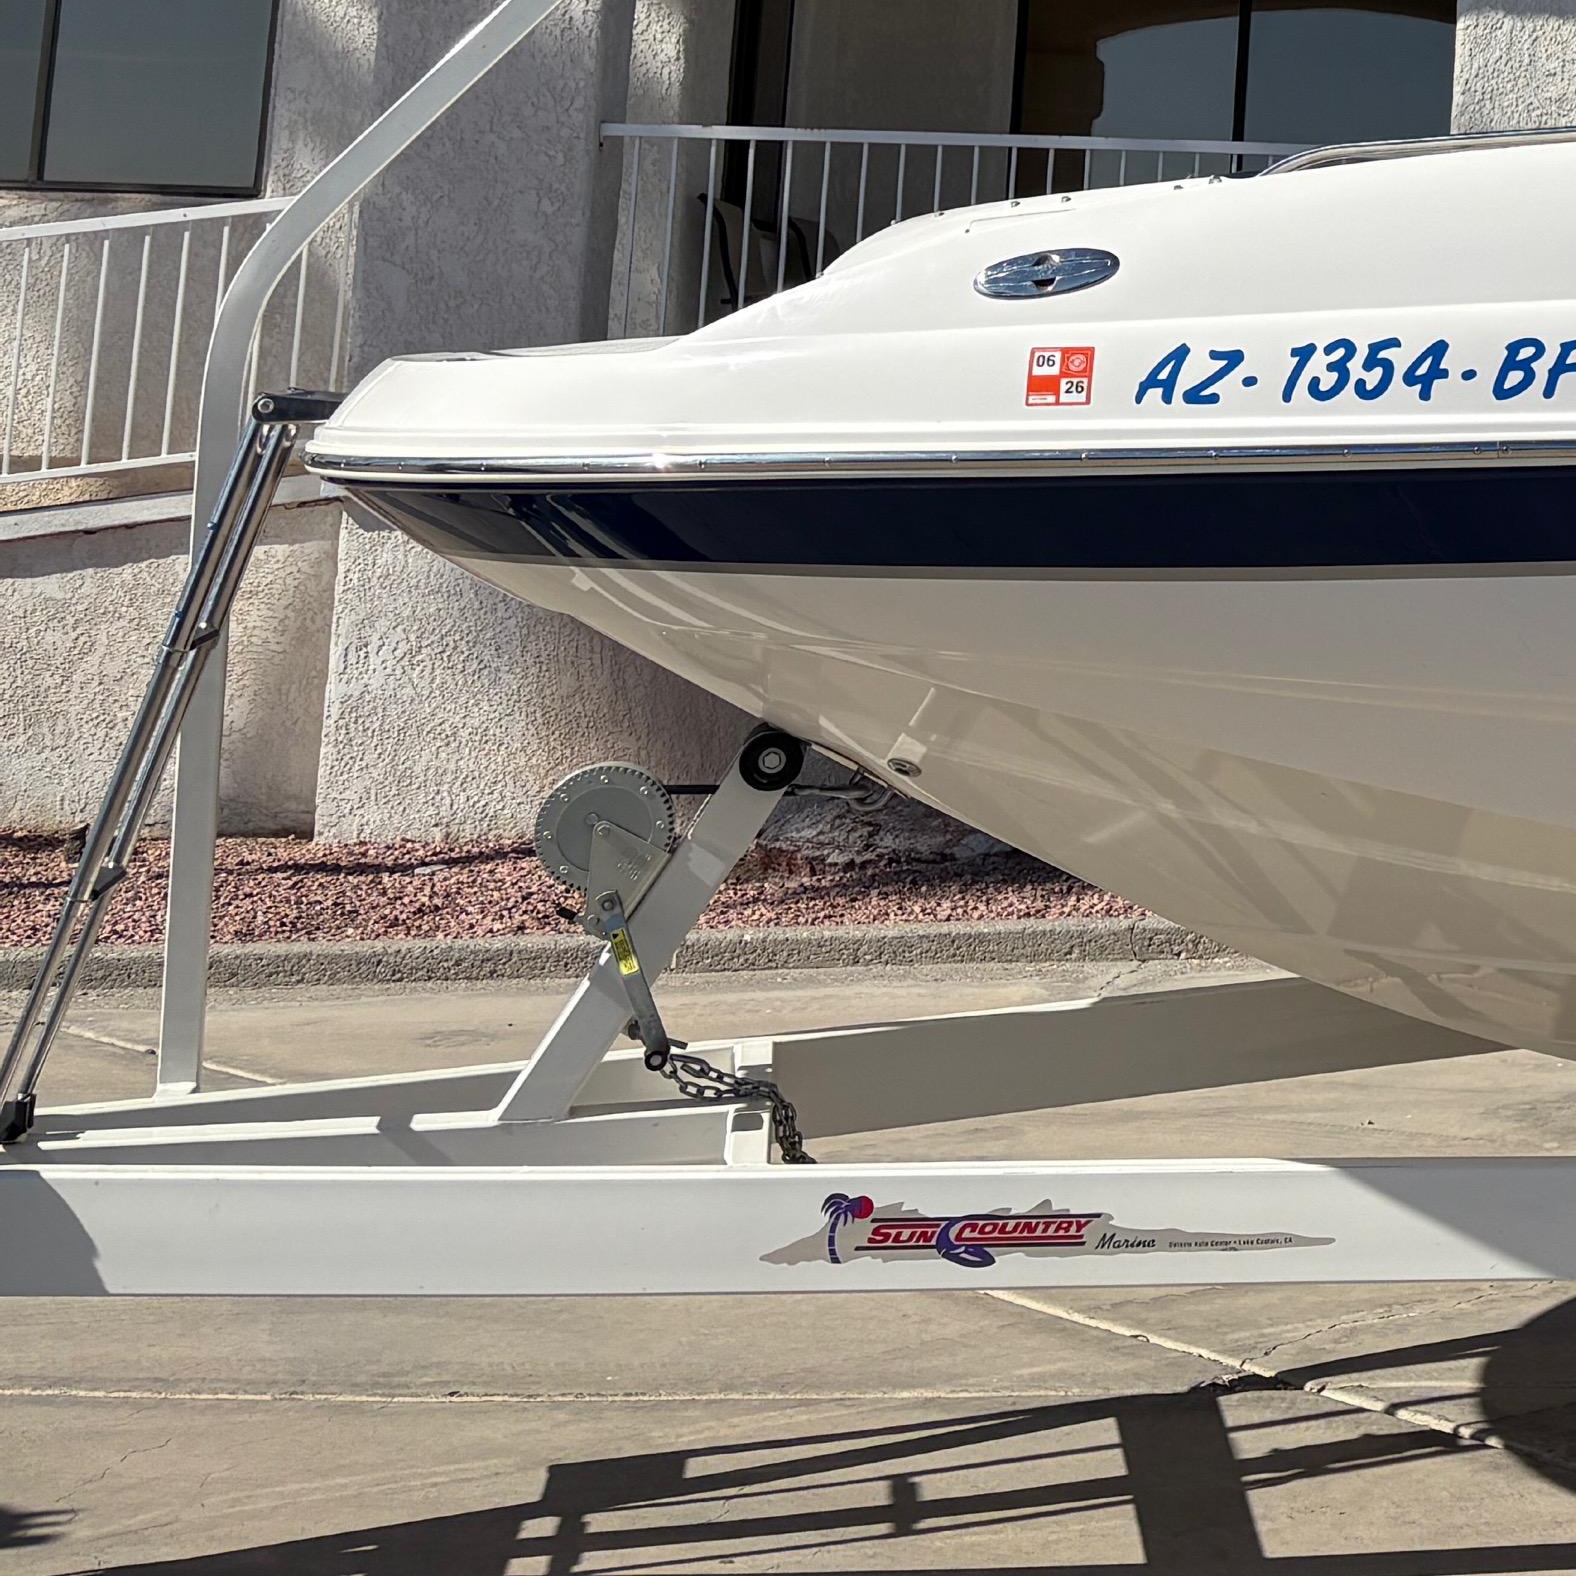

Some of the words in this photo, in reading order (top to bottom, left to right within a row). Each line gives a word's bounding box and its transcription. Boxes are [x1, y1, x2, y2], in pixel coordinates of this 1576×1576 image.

[1036, 354, 1056, 368] 06
[1064, 380, 1085, 394] 26
[867, 1222, 938, 1245] SUN
[953, 1219, 1094, 1243] COUNTRY
[1095, 1232, 1156, 1251] Marine
